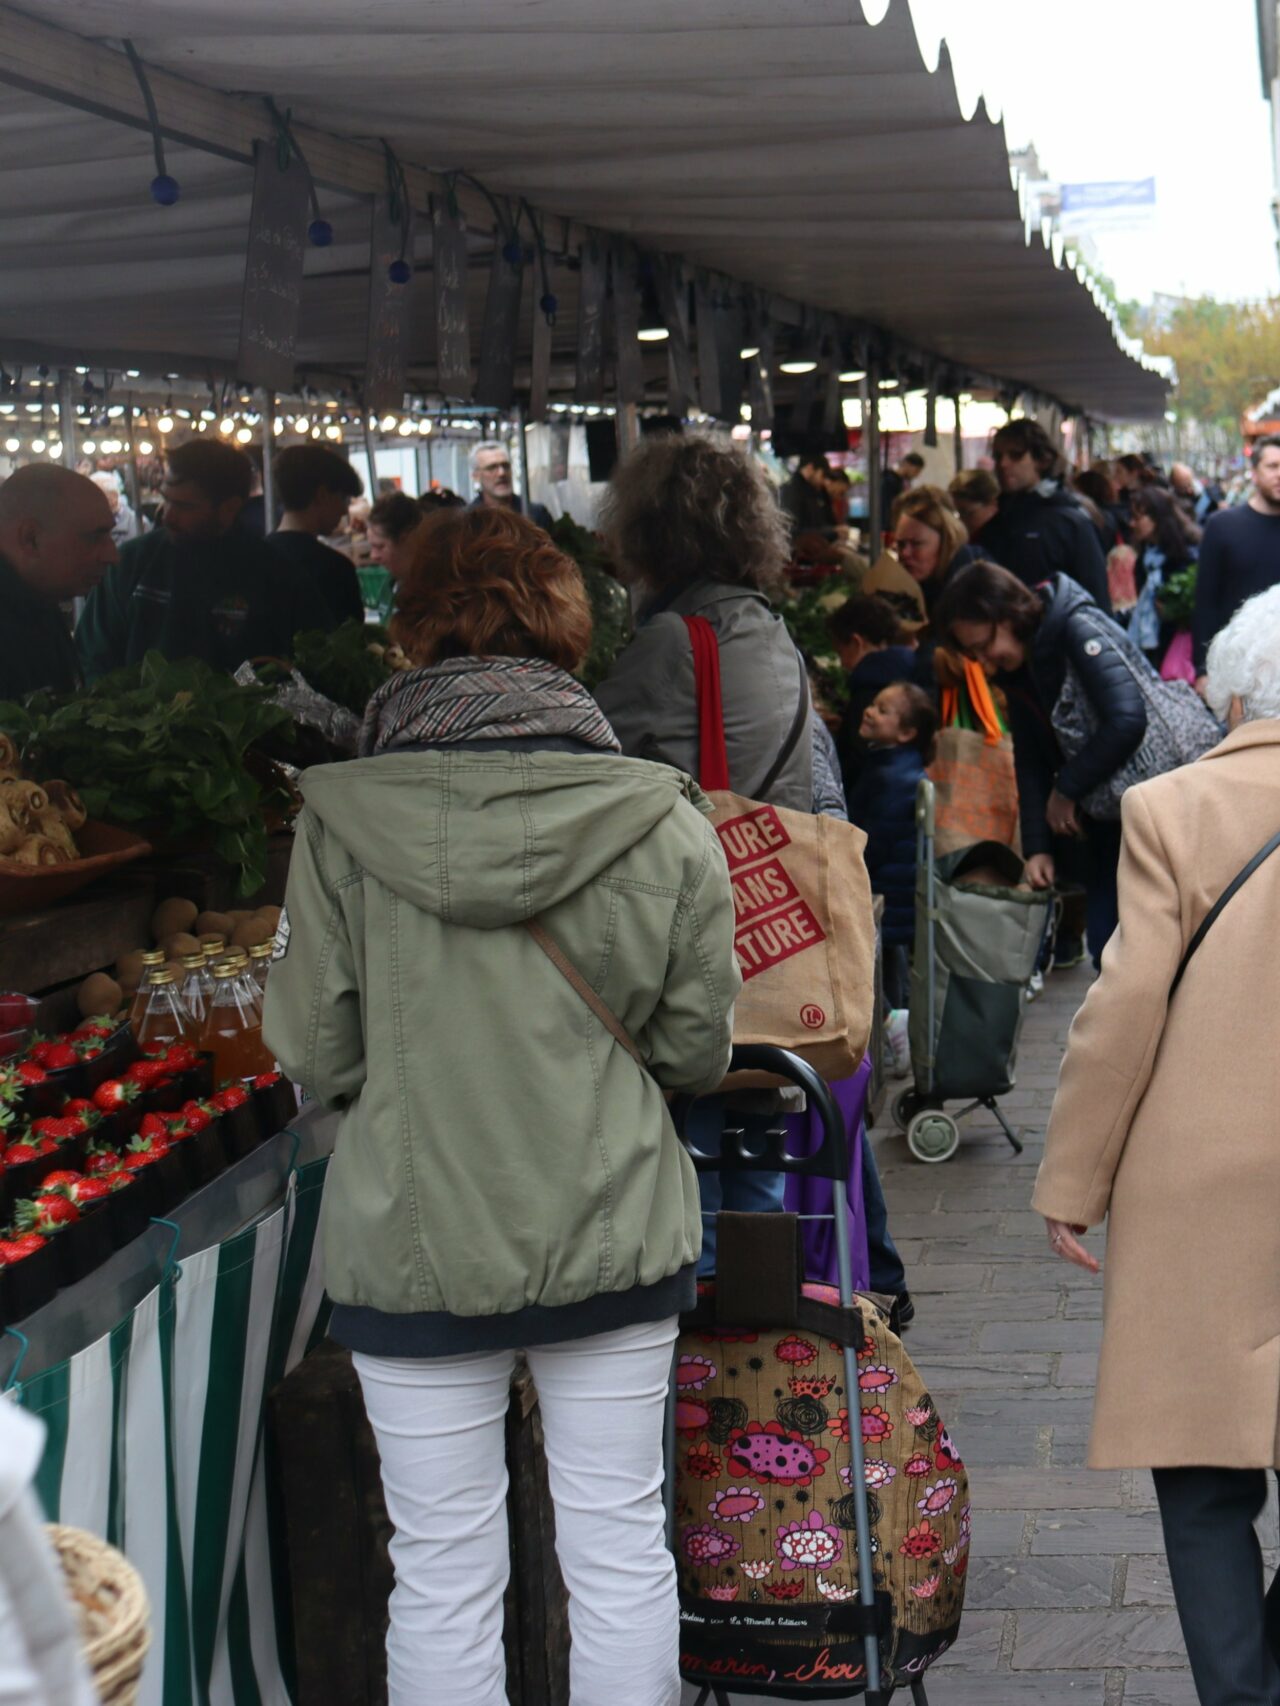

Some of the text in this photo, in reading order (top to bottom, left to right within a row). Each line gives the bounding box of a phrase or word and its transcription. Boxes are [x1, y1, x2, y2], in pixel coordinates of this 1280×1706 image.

[719, 812, 784, 860] URE
[731, 867, 789, 916] ANS
[730, 1616, 742, 1625] La
